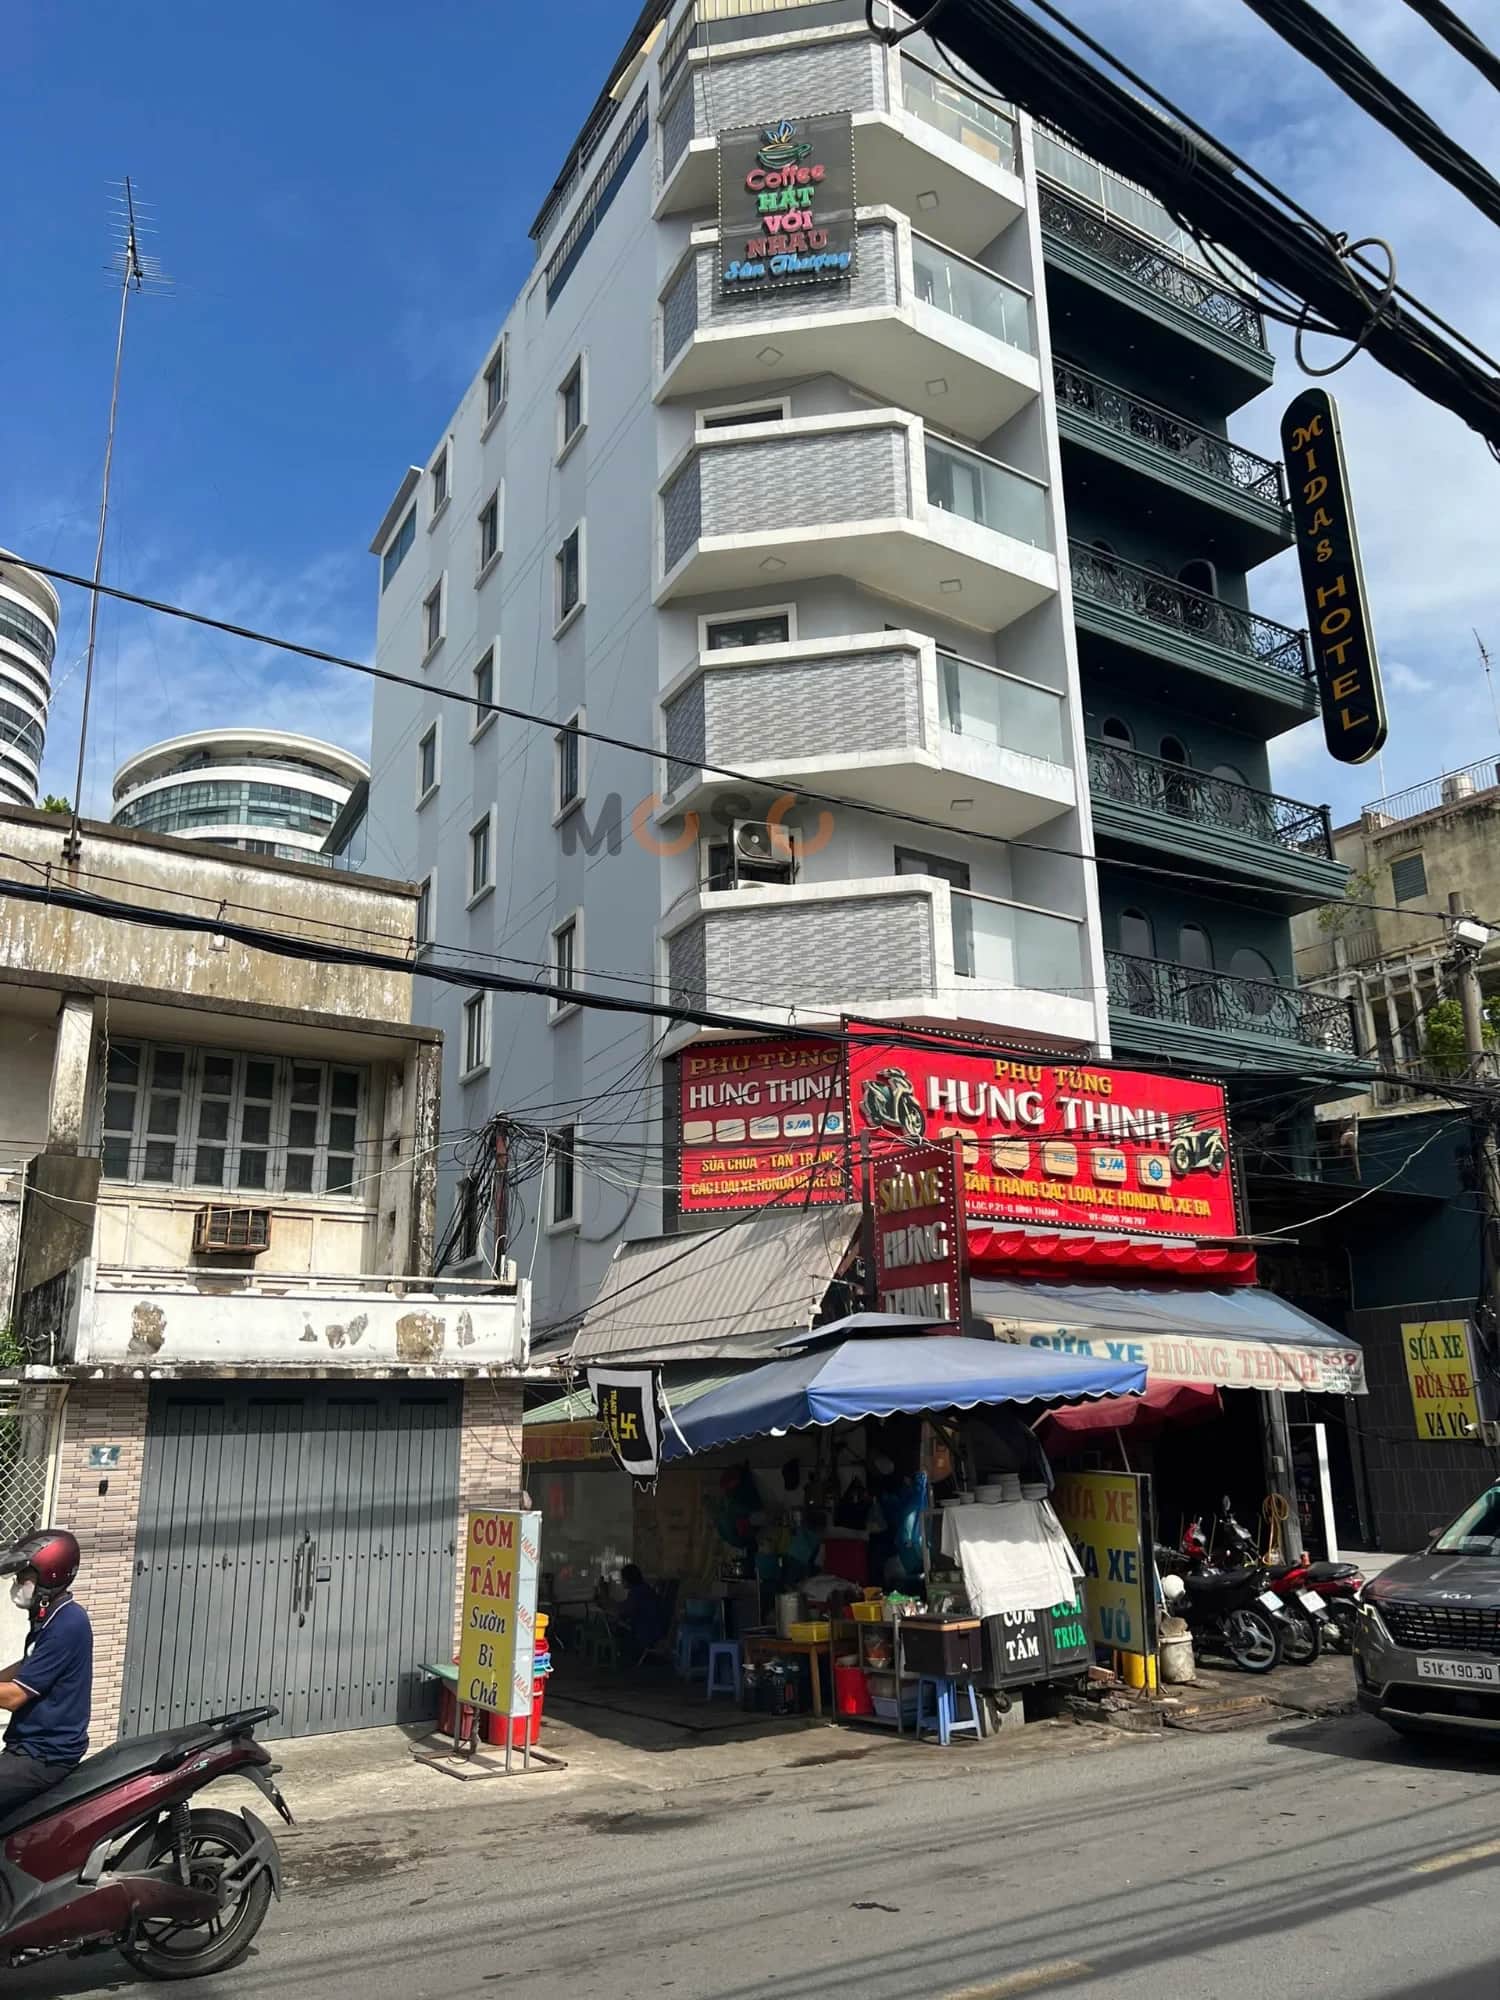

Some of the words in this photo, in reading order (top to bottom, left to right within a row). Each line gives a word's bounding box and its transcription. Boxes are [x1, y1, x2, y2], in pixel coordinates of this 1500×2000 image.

[746, 164, 826, 190] Coffee
[747, 229, 829, 258] NHAU
[1292, 415, 1335, 563] MIDAS
[1316, 575, 1369, 731] HOTEL
[690, 1055, 750, 1076] PHỤ
[995, 1060, 1041, 1088] PHỤ
[690, 1081, 760, 1109] HƯNG
[765, 1074, 842, 1105] THỊNH
[926, 1076, 1045, 1125] HƯNG
[1058, 1096, 1171, 1144] THỊNH
[1118, 1192, 1158, 1211] HONDA
[883, 1221, 949, 1269] HƯNG
[1151, 1340, 1232, 1379] HƯNG
[1409, 1328, 1439, 1360] SỬA
[1441, 1335, 1464, 1359] XE
[1414, 1366, 1445, 1398] RỬA
[1446, 1373, 1469, 1397] XE
[1425, 1403, 1446, 1437] VÁ
[1104, 1488, 1136, 1524] XE
[473, 1514, 513, 1549] CƠM
[470, 1556, 512, 1600] TẤM
[1108, 1548, 1138, 1584] XE
[470, 1606, 505, 1634] Sườn
[1100, 1597, 1132, 1644] VỎ
[478, 1643, 494, 1668] Bì
[1005, 1628, 1040, 1661] TẤM
[1423, 1660, 1493, 1681] 51K-190.30
[470, 1676, 498, 1707] Chả
